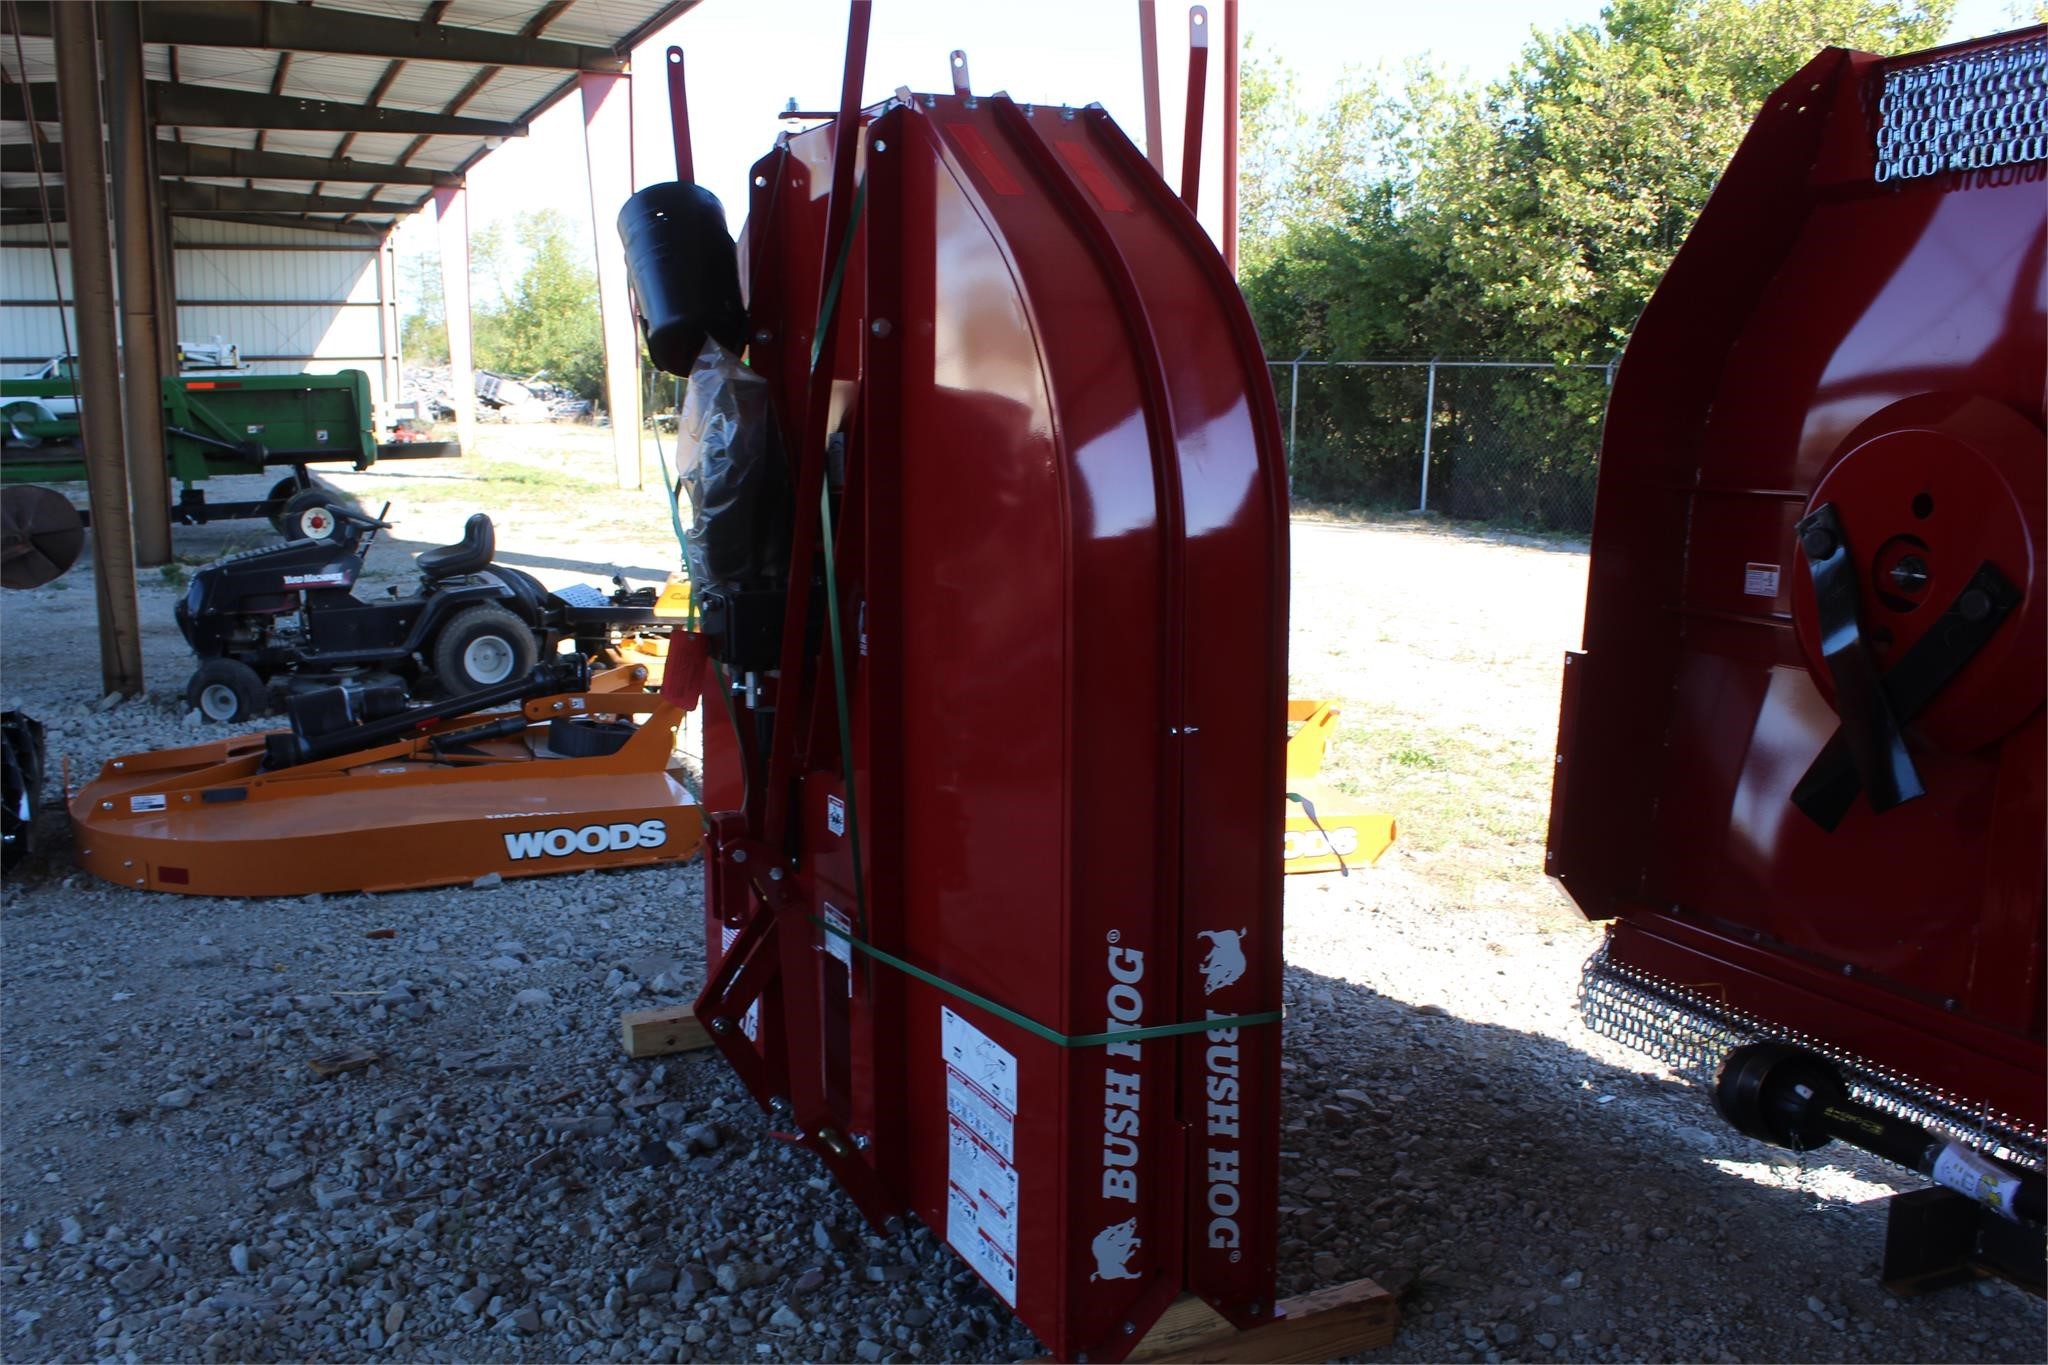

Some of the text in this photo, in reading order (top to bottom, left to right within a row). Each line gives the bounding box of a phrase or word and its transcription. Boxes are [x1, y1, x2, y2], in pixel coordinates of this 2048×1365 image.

[504, 818, 667, 861] WOODS
[1102, 1067, 1142, 1204] BUSH
[1205, 1009, 1241, 1139] BUSH
